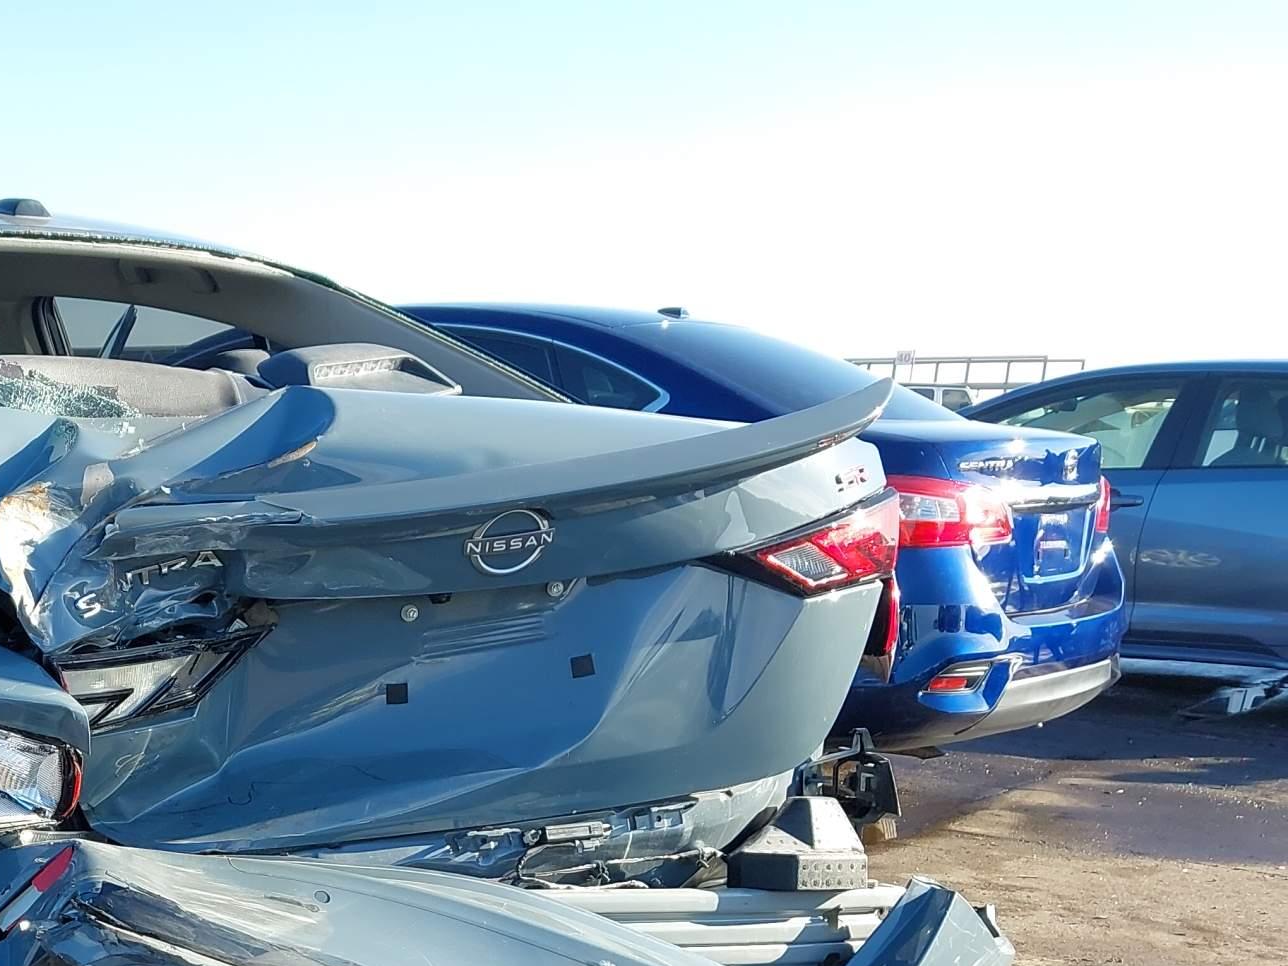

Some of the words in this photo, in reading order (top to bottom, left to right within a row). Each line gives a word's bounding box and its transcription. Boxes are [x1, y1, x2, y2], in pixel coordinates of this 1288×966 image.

[959, 459, 1014, 471] SENTRA
[466, 531, 553, 554] NISSAN
[73, 551, 223, 619] SNTRA
